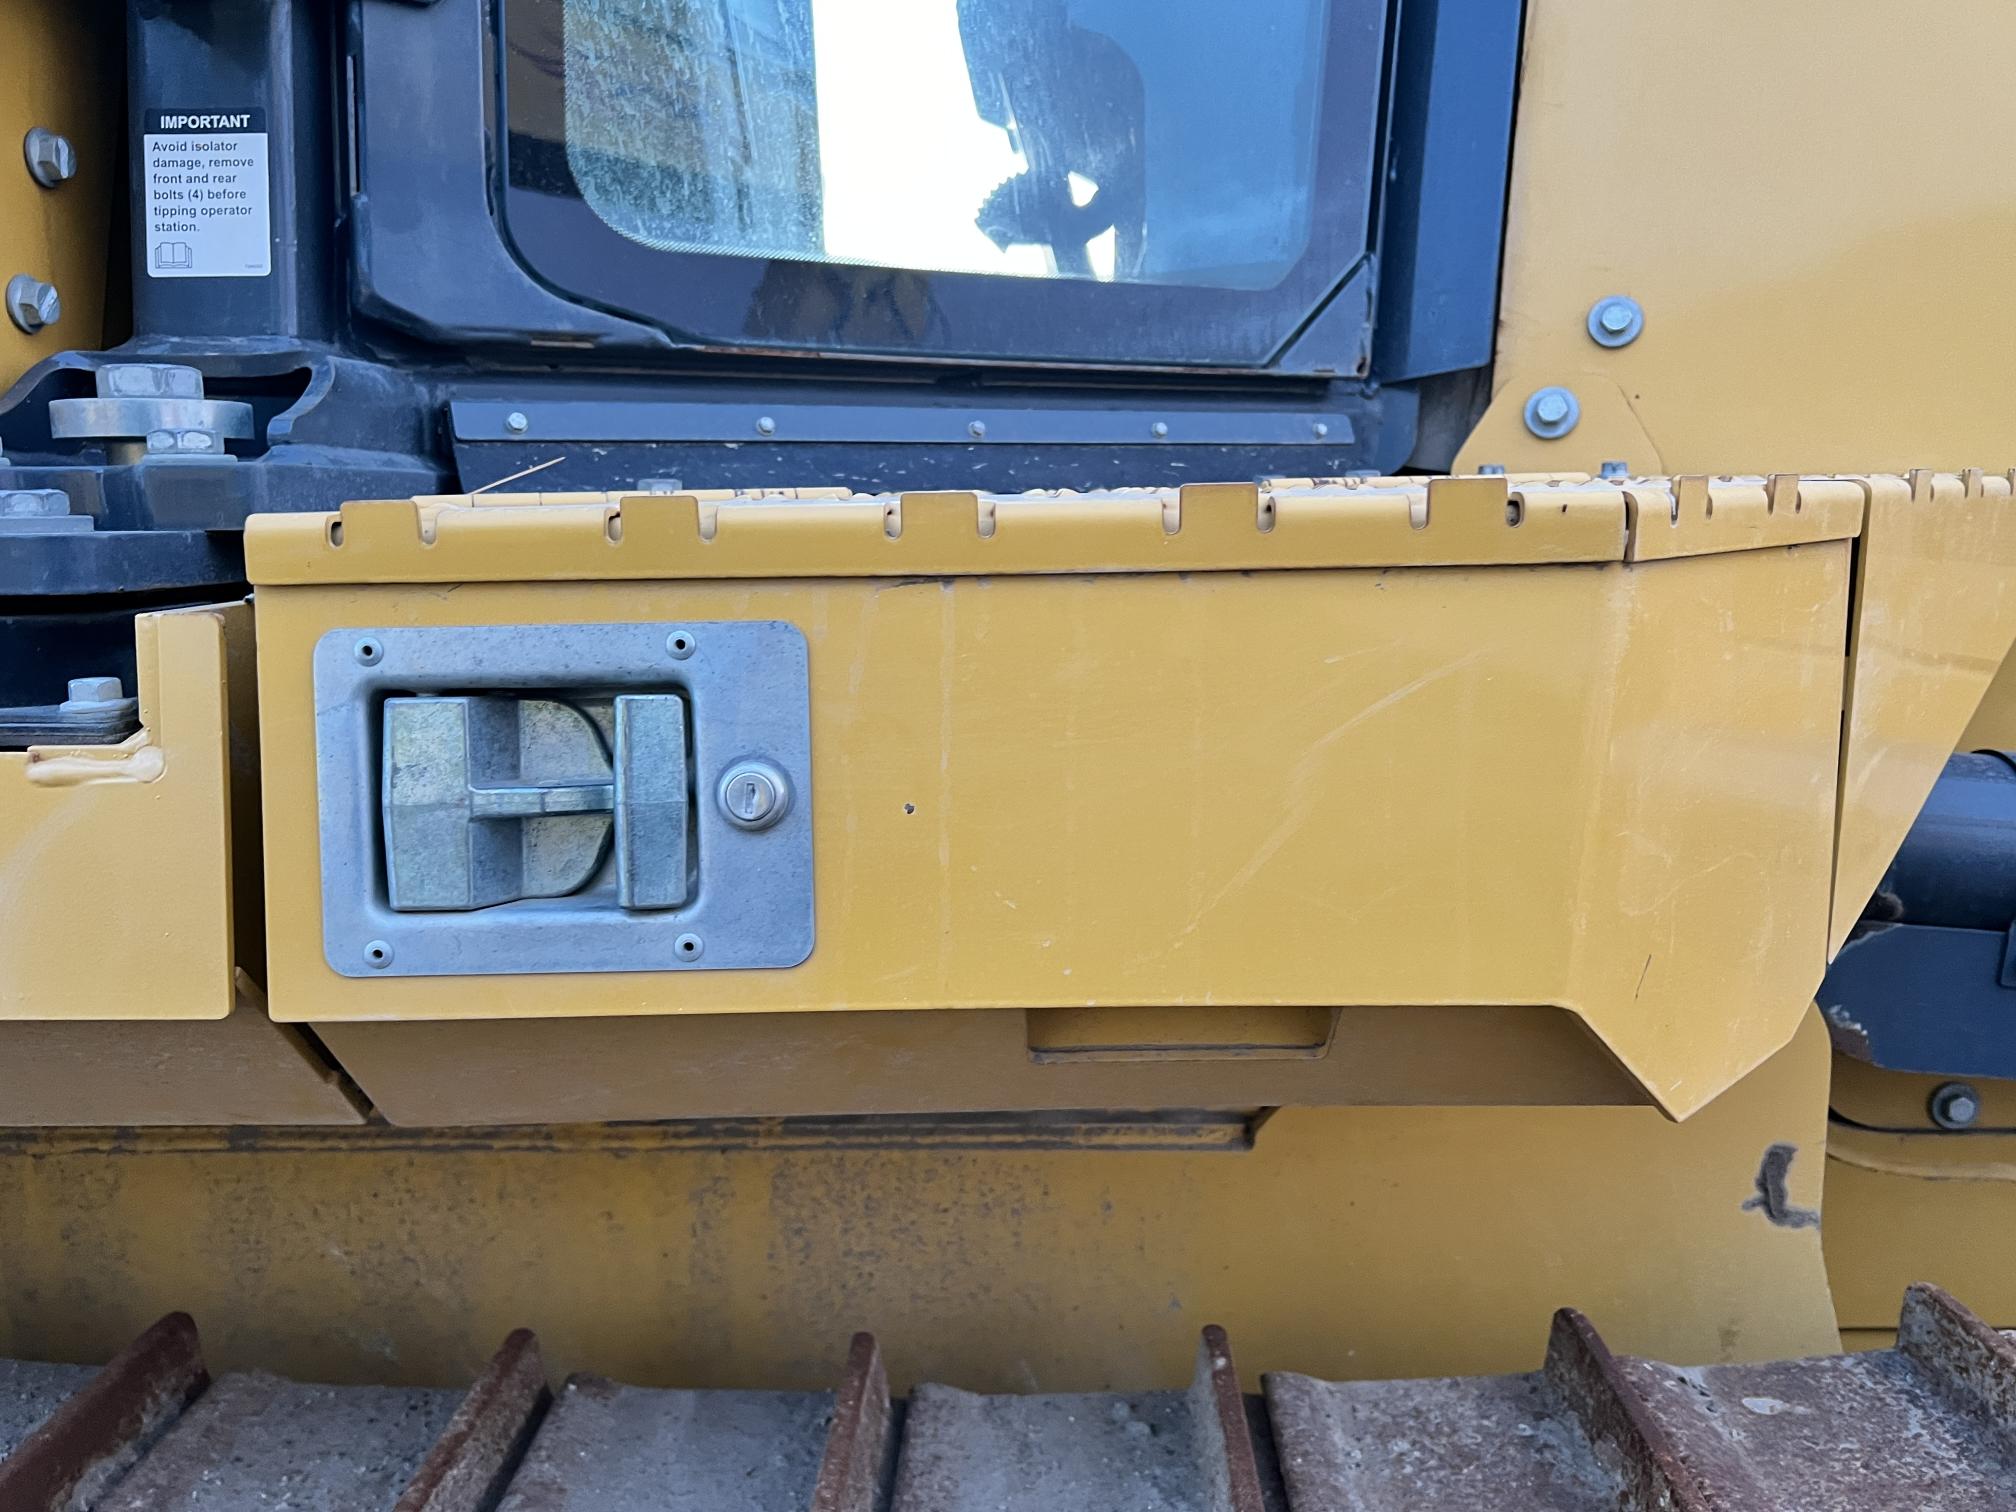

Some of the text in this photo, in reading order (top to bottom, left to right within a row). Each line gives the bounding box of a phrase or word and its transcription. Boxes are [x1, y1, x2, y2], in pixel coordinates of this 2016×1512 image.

[160, 114, 251, 129] IMPORTANT
[152, 141, 238, 152] Avoid isolator
[152, 157, 254, 170] damage, remove
[153, 173, 237, 184] front and rear
[153, 188, 247, 202] bolts (4) before
[154, 205, 253, 218] tipping operator
[154, 221, 200, 232] station.
